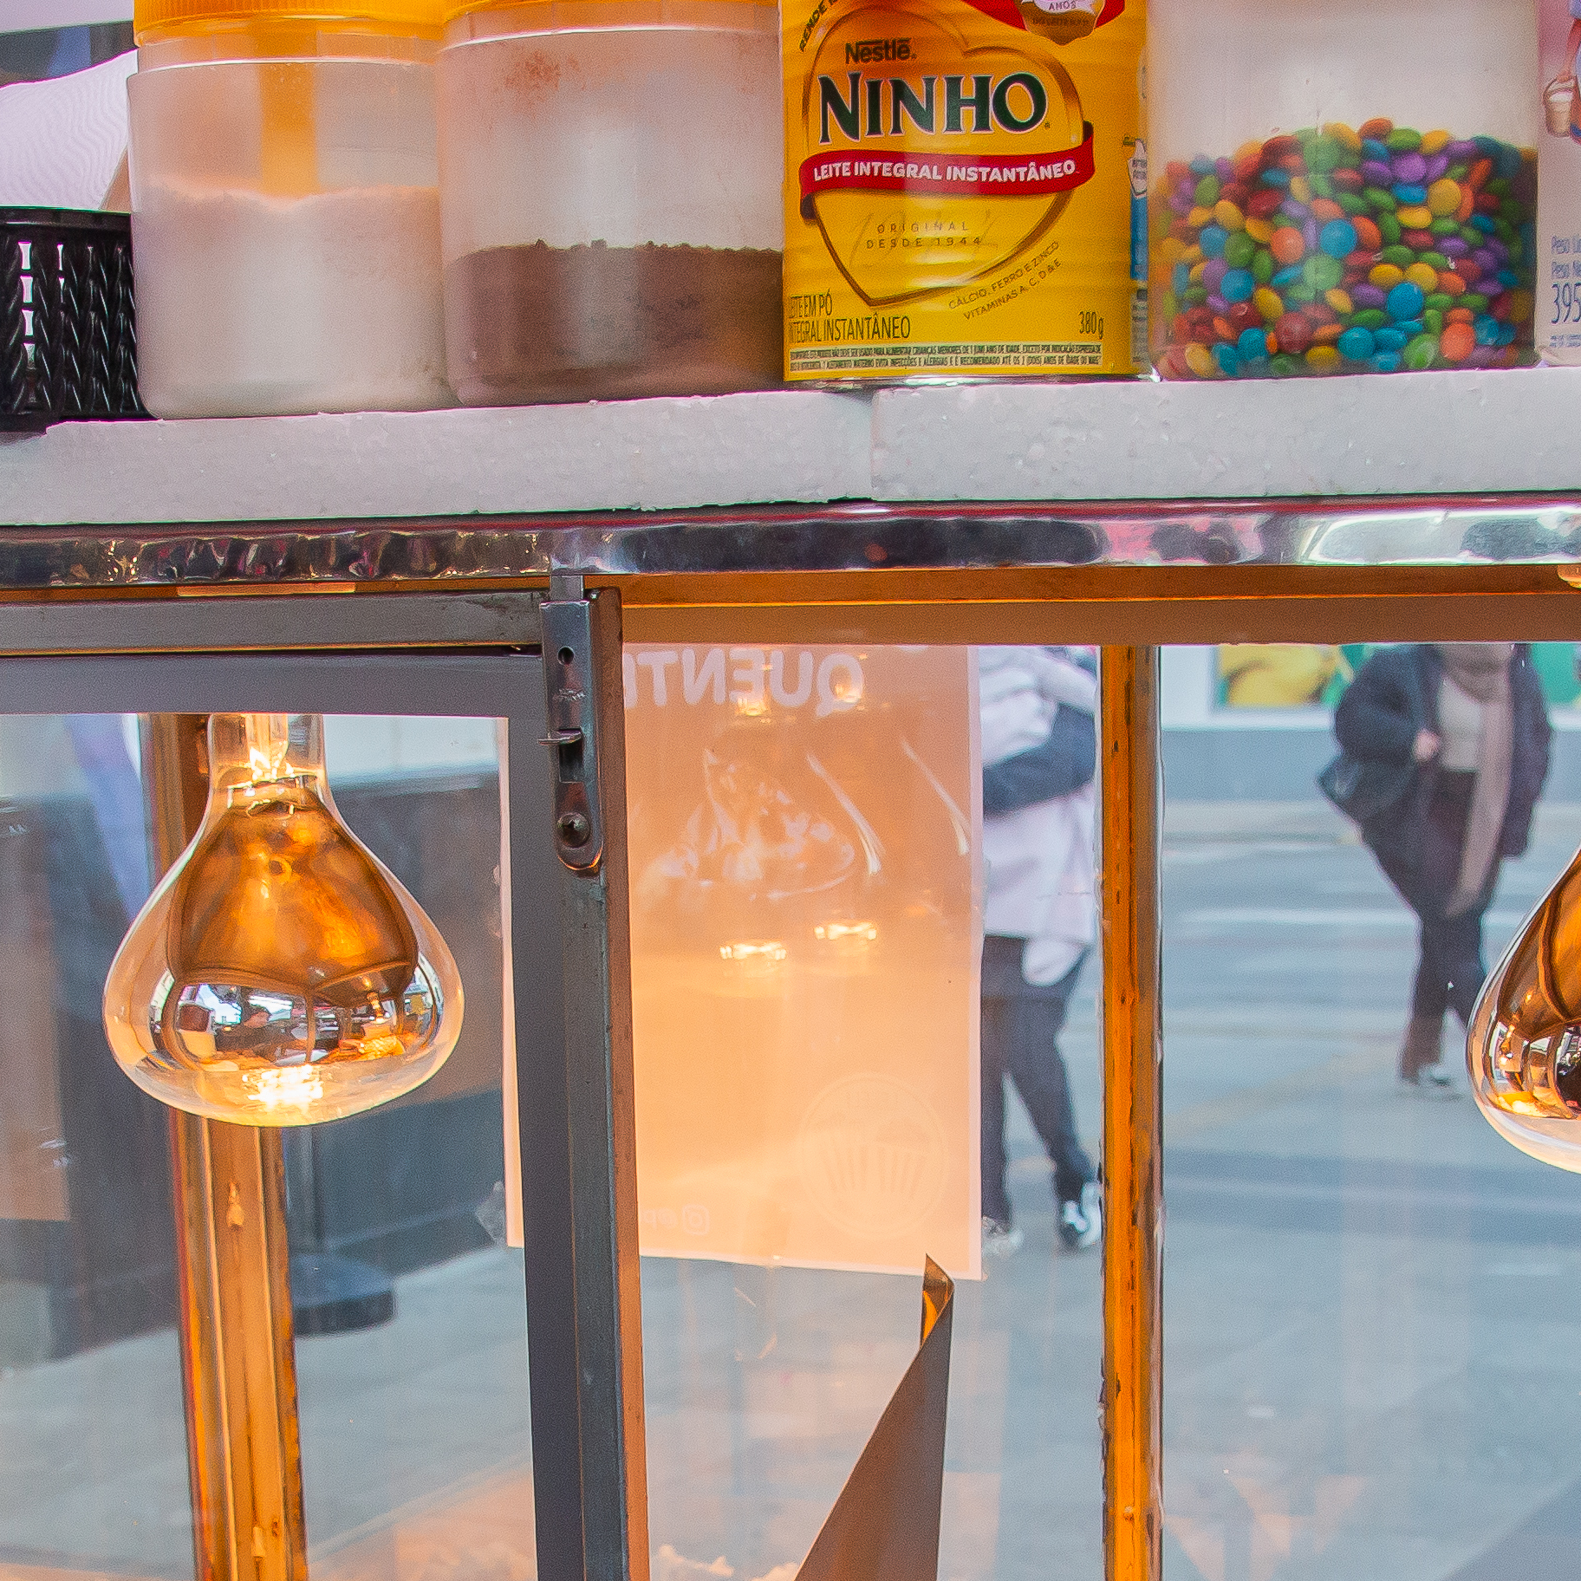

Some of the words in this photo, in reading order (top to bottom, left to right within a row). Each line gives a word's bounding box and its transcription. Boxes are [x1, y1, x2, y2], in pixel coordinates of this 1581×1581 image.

[844, 37, 911, 65] Nestlé
[817, 70, 1049, 145] NINHO
[813, 161, 851, 182] LEITE
[853, 161, 942, 181] INTEGRAL
[946, 159, 1077, 184] INSTANTÂNEO
[877, 221, 968, 234] ORIGINAL
[866, 237, 923, 249] DESDE
[935, 237, 981, 246] 1944
[991, 268, 1024, 292] FERRO
[819, 288, 833, 317] PÓ
[963, 288, 1019, 321] VITAMINAS
[823, 312, 912, 341] INSTANTÂNEO
